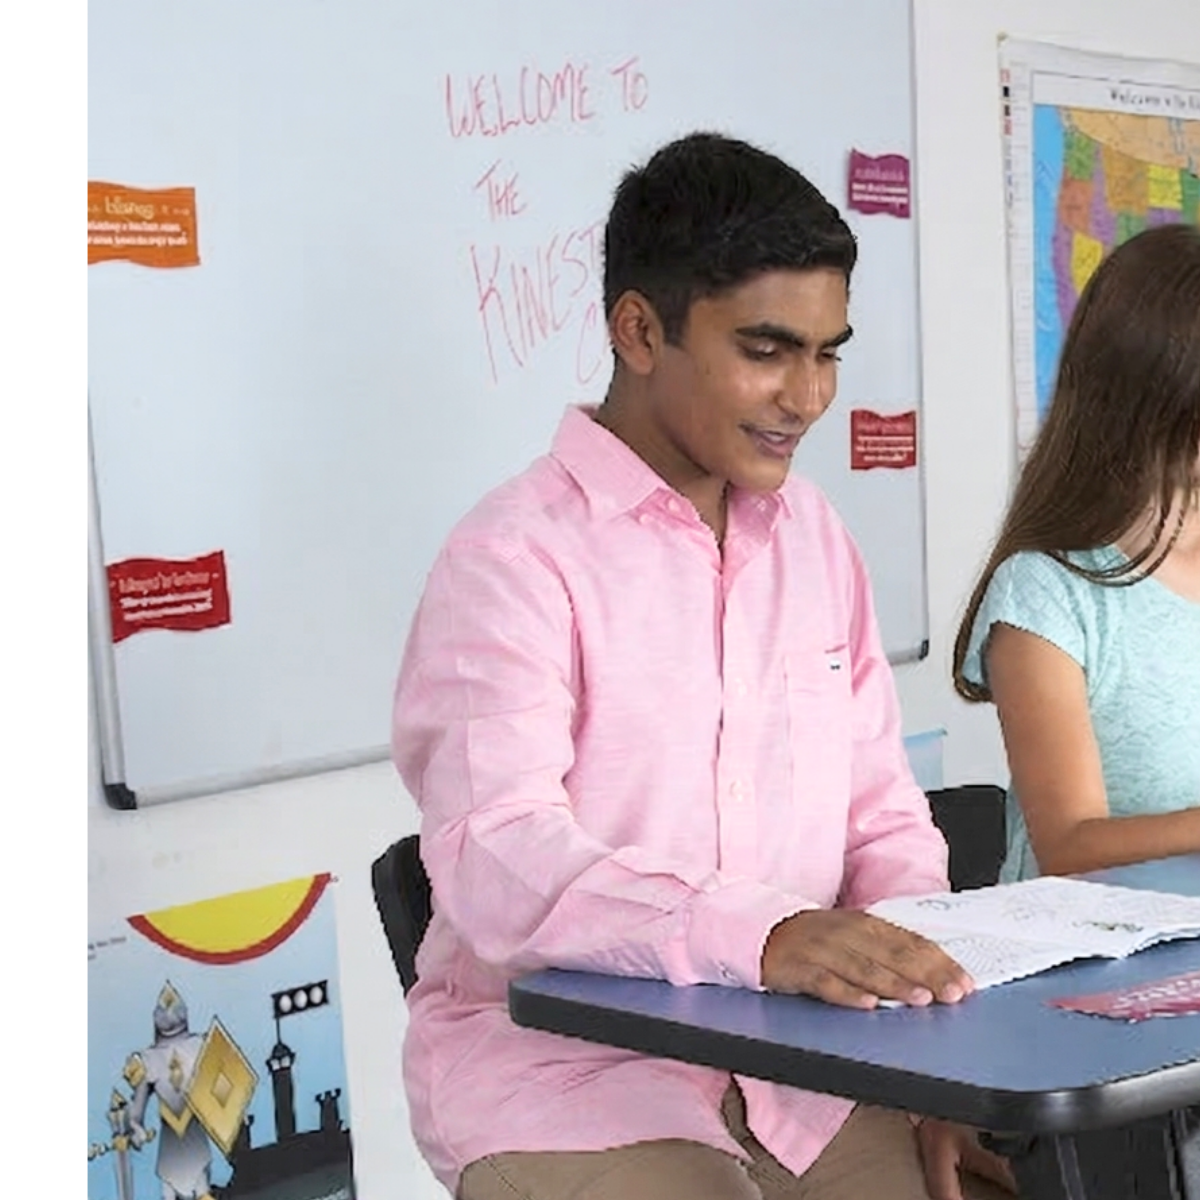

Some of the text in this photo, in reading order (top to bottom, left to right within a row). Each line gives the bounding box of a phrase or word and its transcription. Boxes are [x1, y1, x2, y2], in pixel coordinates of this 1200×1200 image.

[444, 55, 650, 138] WELCOME TO
[474, 158, 528, 223] THE
